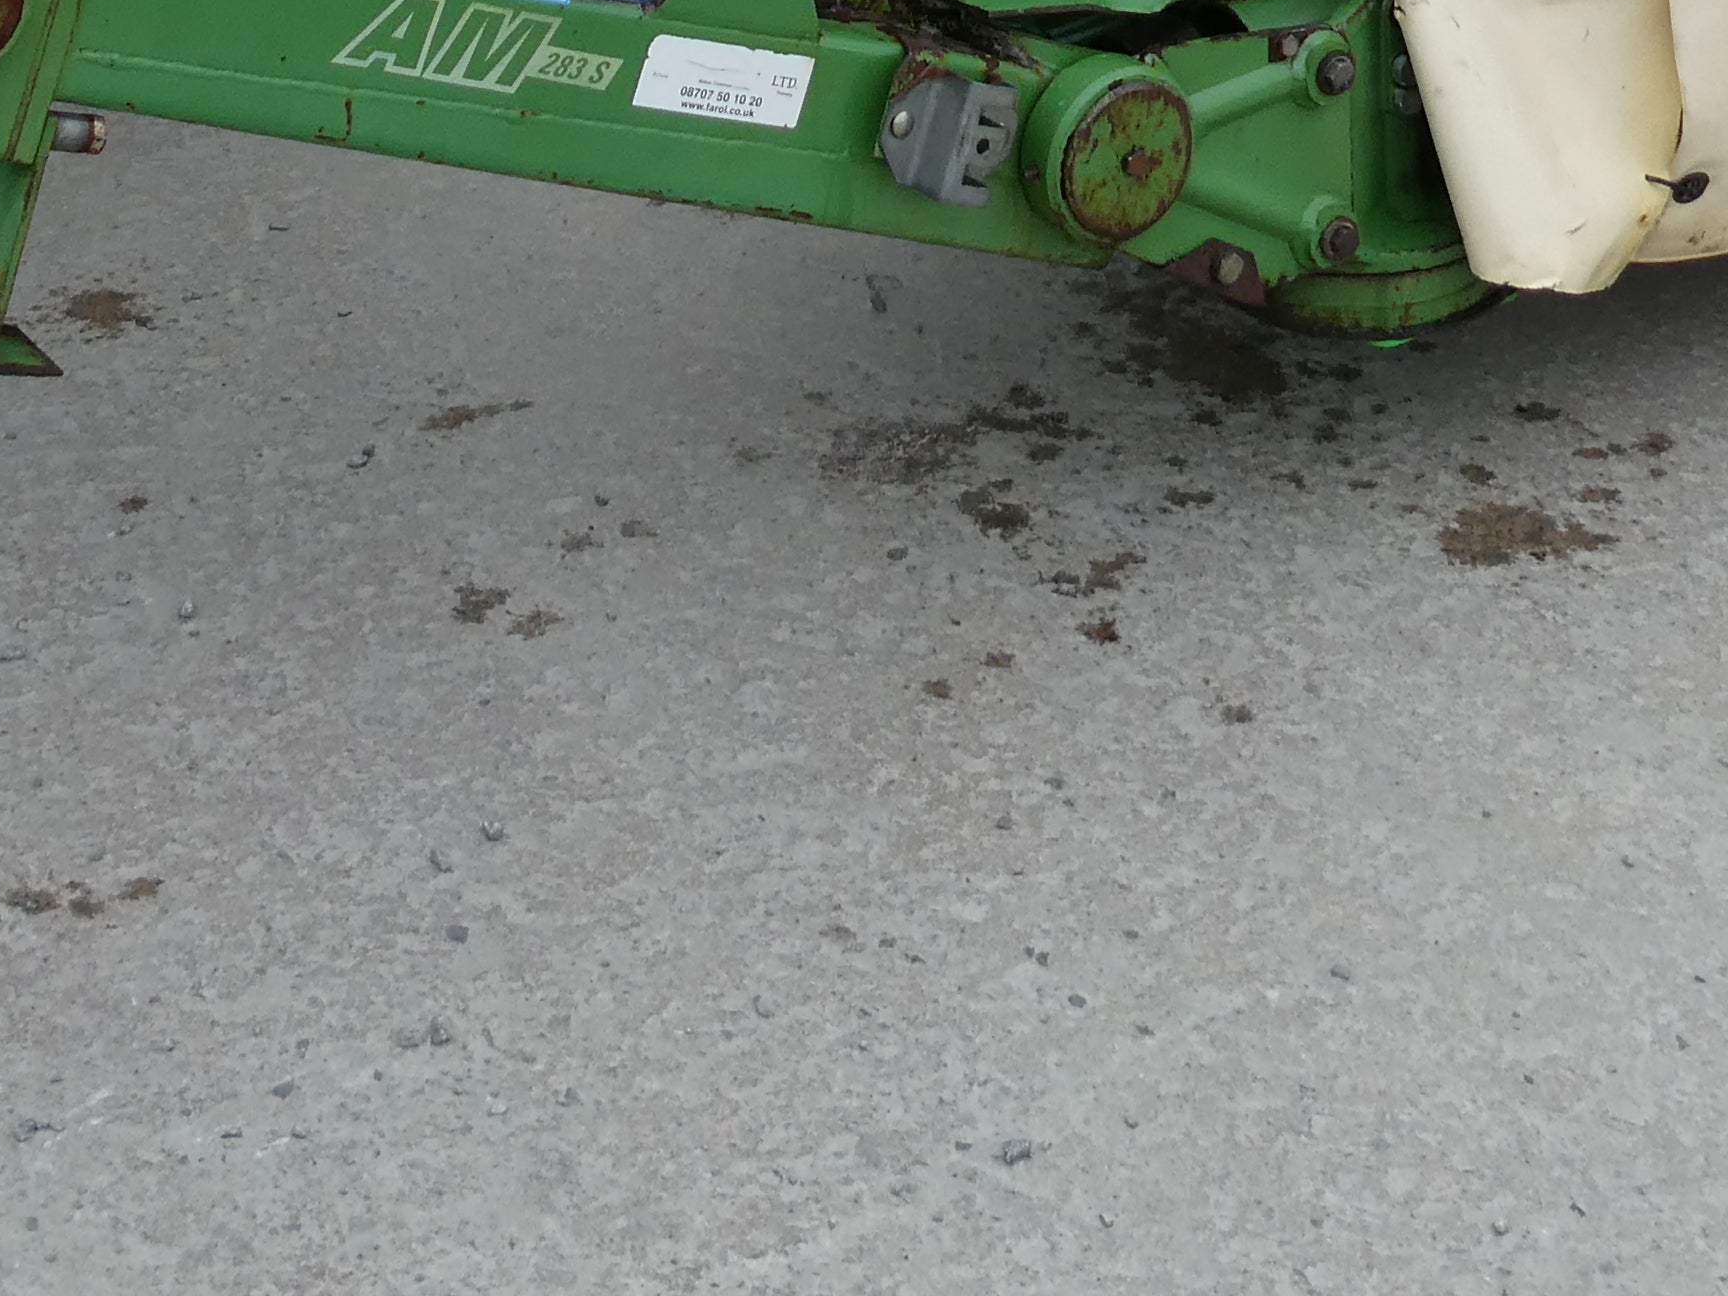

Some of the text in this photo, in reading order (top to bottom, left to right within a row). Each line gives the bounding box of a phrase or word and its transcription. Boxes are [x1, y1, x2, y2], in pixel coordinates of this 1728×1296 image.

[539, 49, 591, 81] 283
[591, 59, 612, 86] S
[680, 86, 763, 108] 08707 50 10 20
[680, 101, 755, 118] www.farol.co.uk
